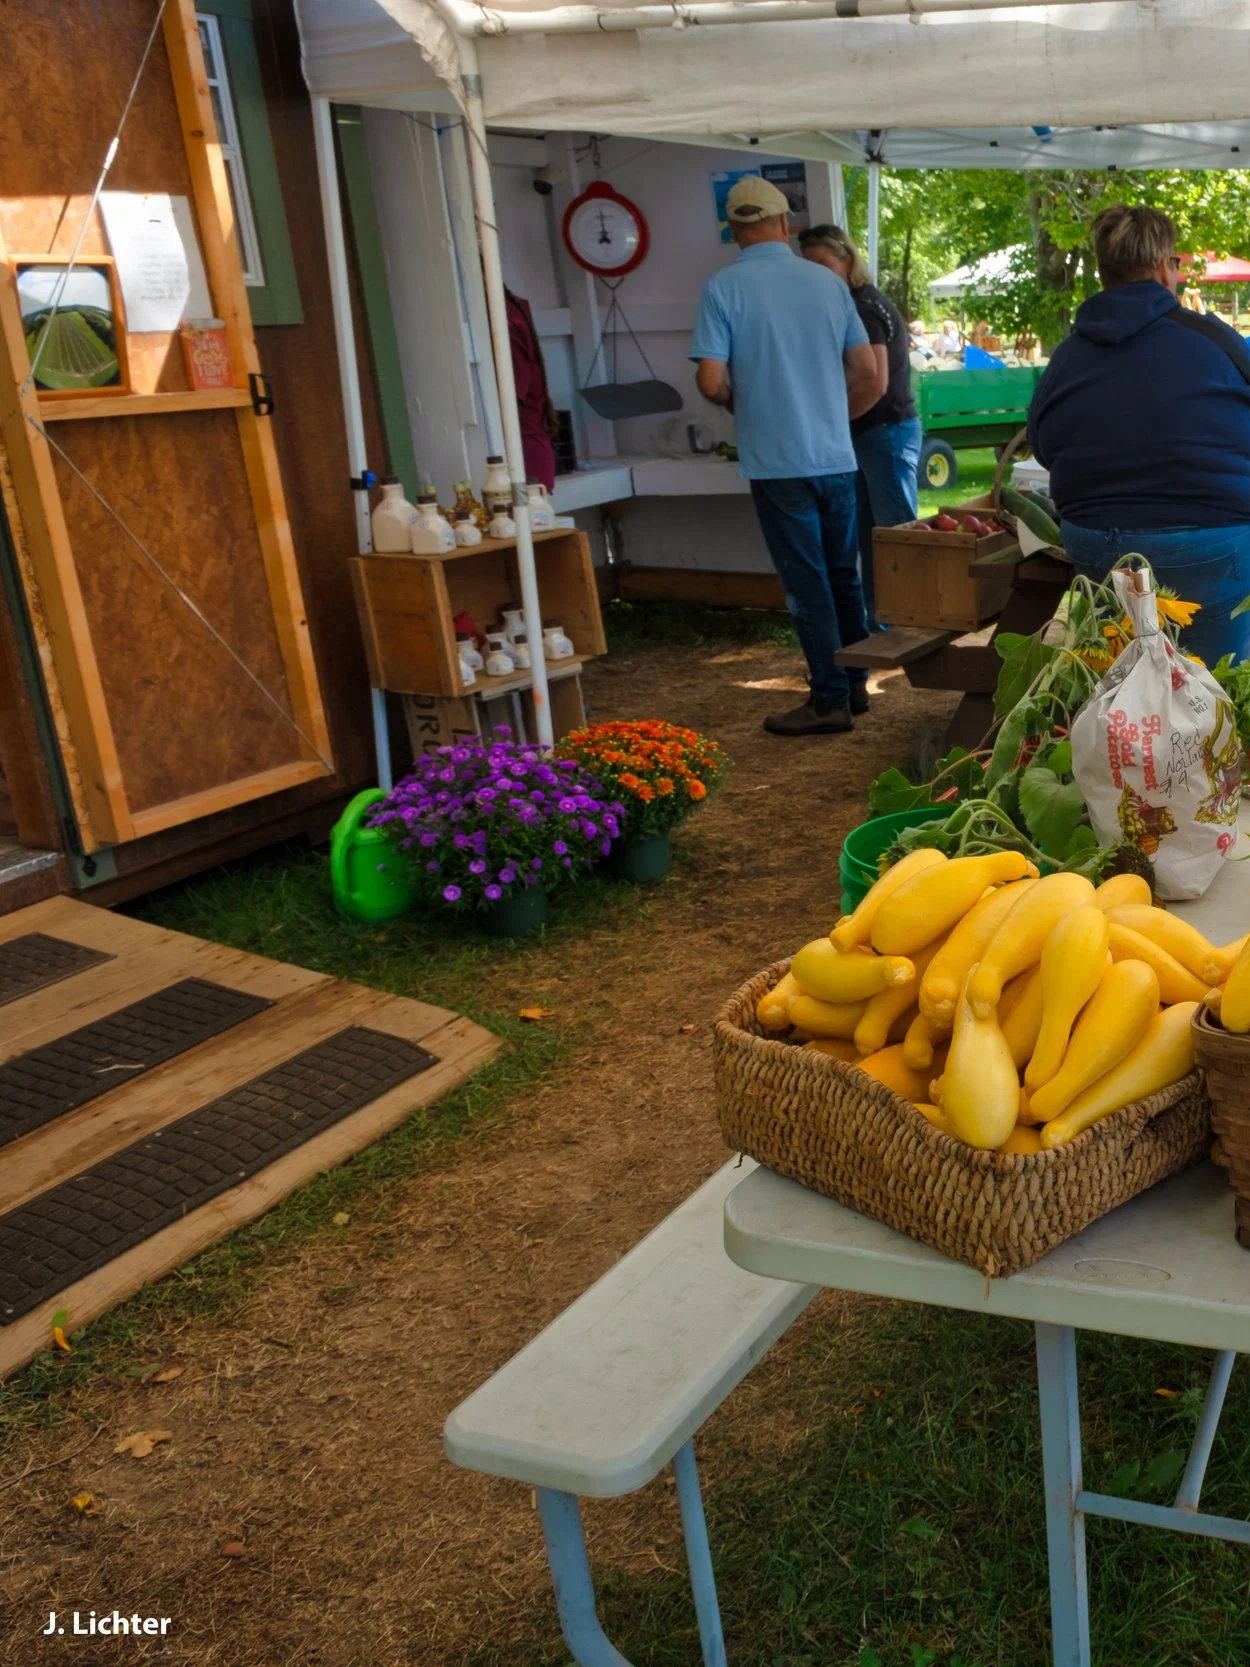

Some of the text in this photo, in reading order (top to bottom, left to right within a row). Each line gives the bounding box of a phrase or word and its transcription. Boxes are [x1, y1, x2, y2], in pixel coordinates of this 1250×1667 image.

[1107, 710, 1127, 789] Potatoes
[1119, 723, 1139, 767] Gold
[1141, 714, 1161, 790] Harvest
[1170, 727, 1202, 754] Red
